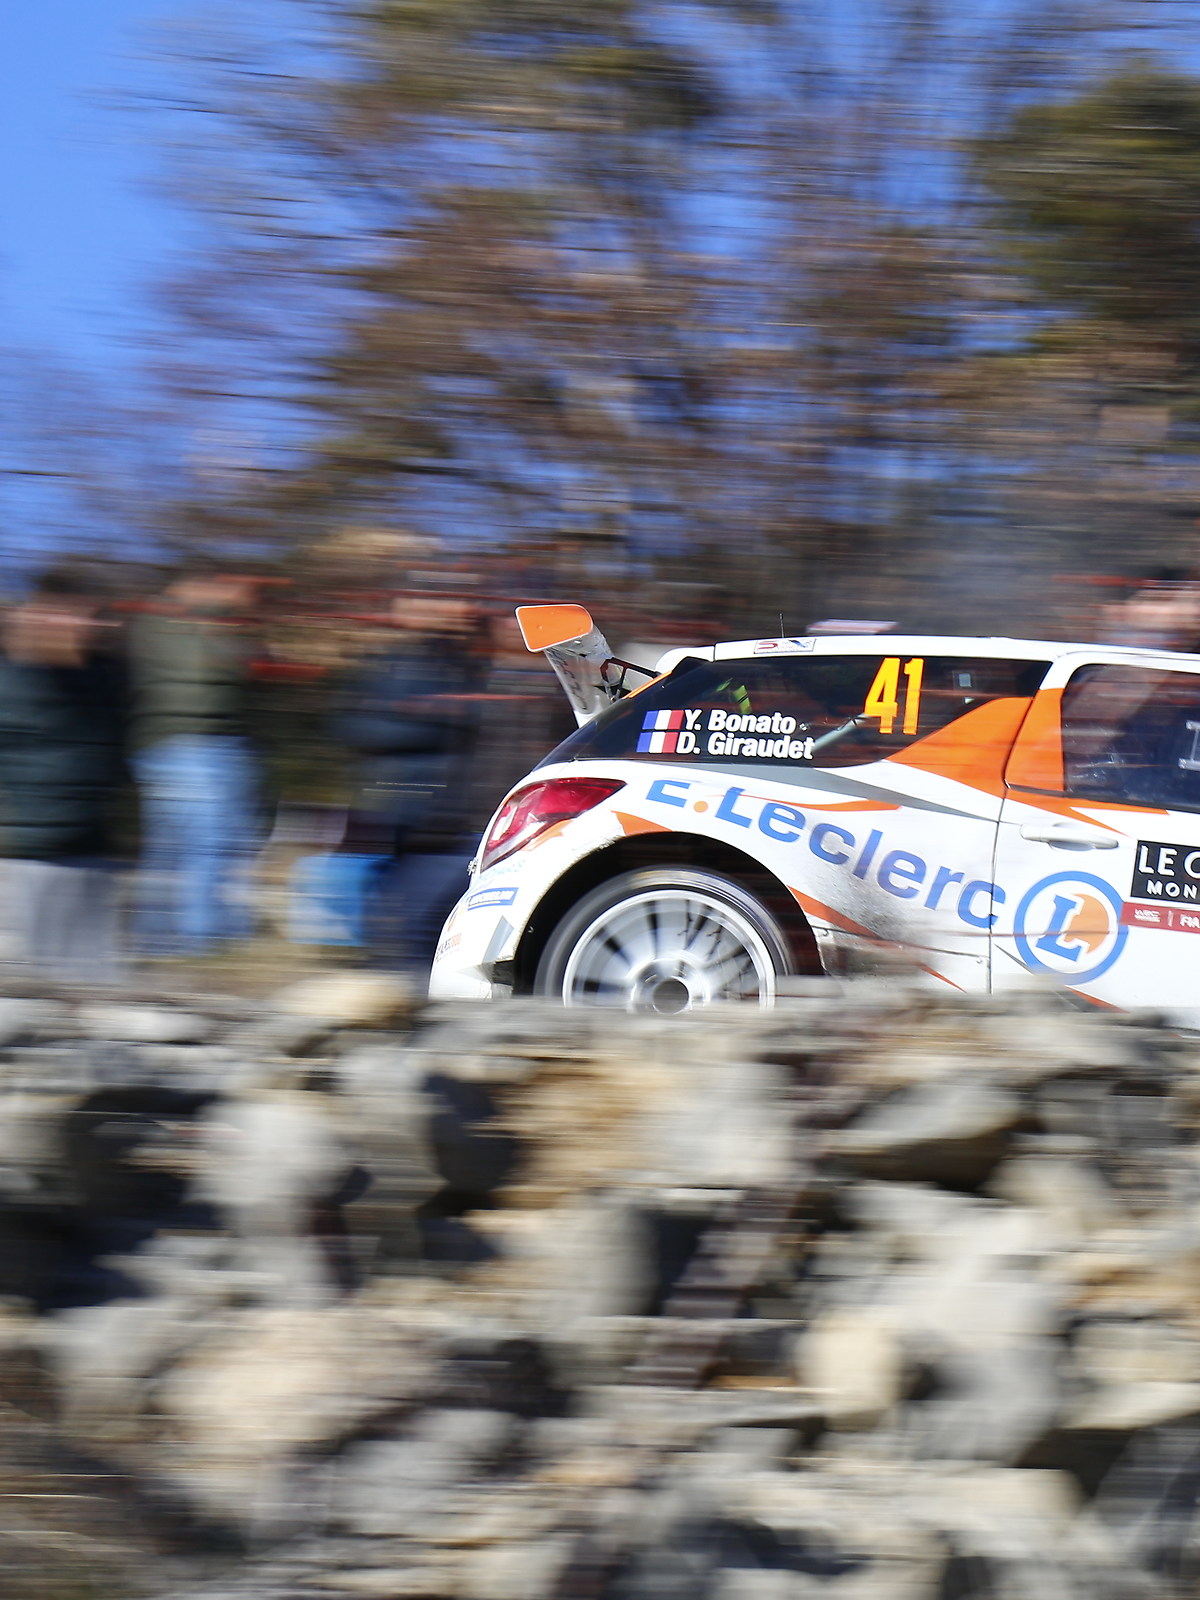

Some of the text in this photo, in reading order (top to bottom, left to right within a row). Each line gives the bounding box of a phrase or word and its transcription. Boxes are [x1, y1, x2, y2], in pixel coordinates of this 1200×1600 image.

[864, 657, 925, 736] 41
[684, 708, 797, 735] Y. Bonato
[676, 731, 816, 760] D. Giraudet
[1138, 845, 1178, 877] LE
[1180, 914, 1200, 929] FIA
